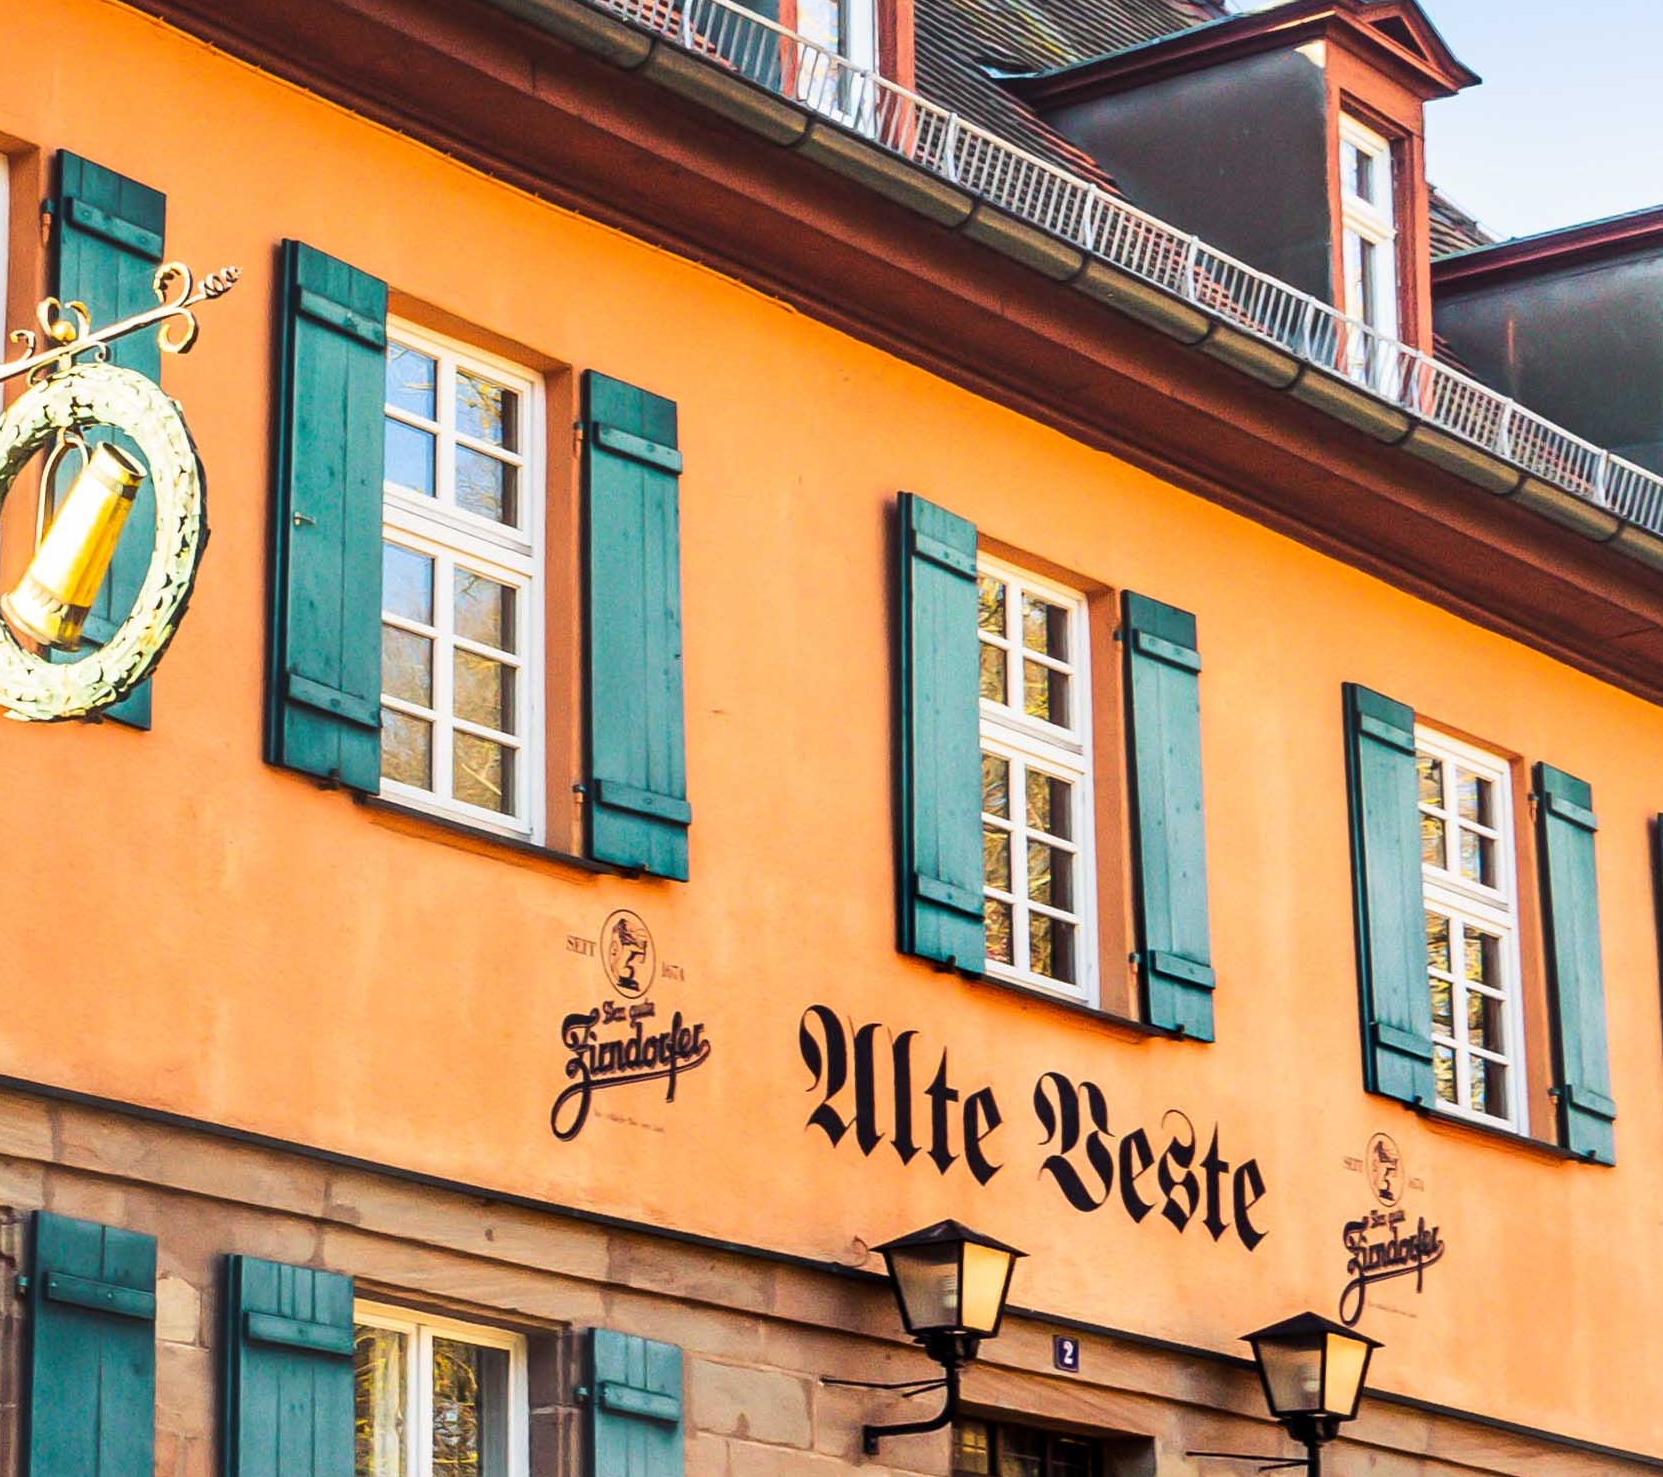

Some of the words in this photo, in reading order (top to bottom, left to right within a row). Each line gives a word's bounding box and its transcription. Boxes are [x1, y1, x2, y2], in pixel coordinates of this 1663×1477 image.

[565, 934, 597, 958] SEIT
[550, 1011, 712, 1142] Zirndorfer
[798, 1004, 1005, 1186] Alte
[1033, 1071, 1270, 1252] Veste
[1063, 1340, 1074, 1365] 2
